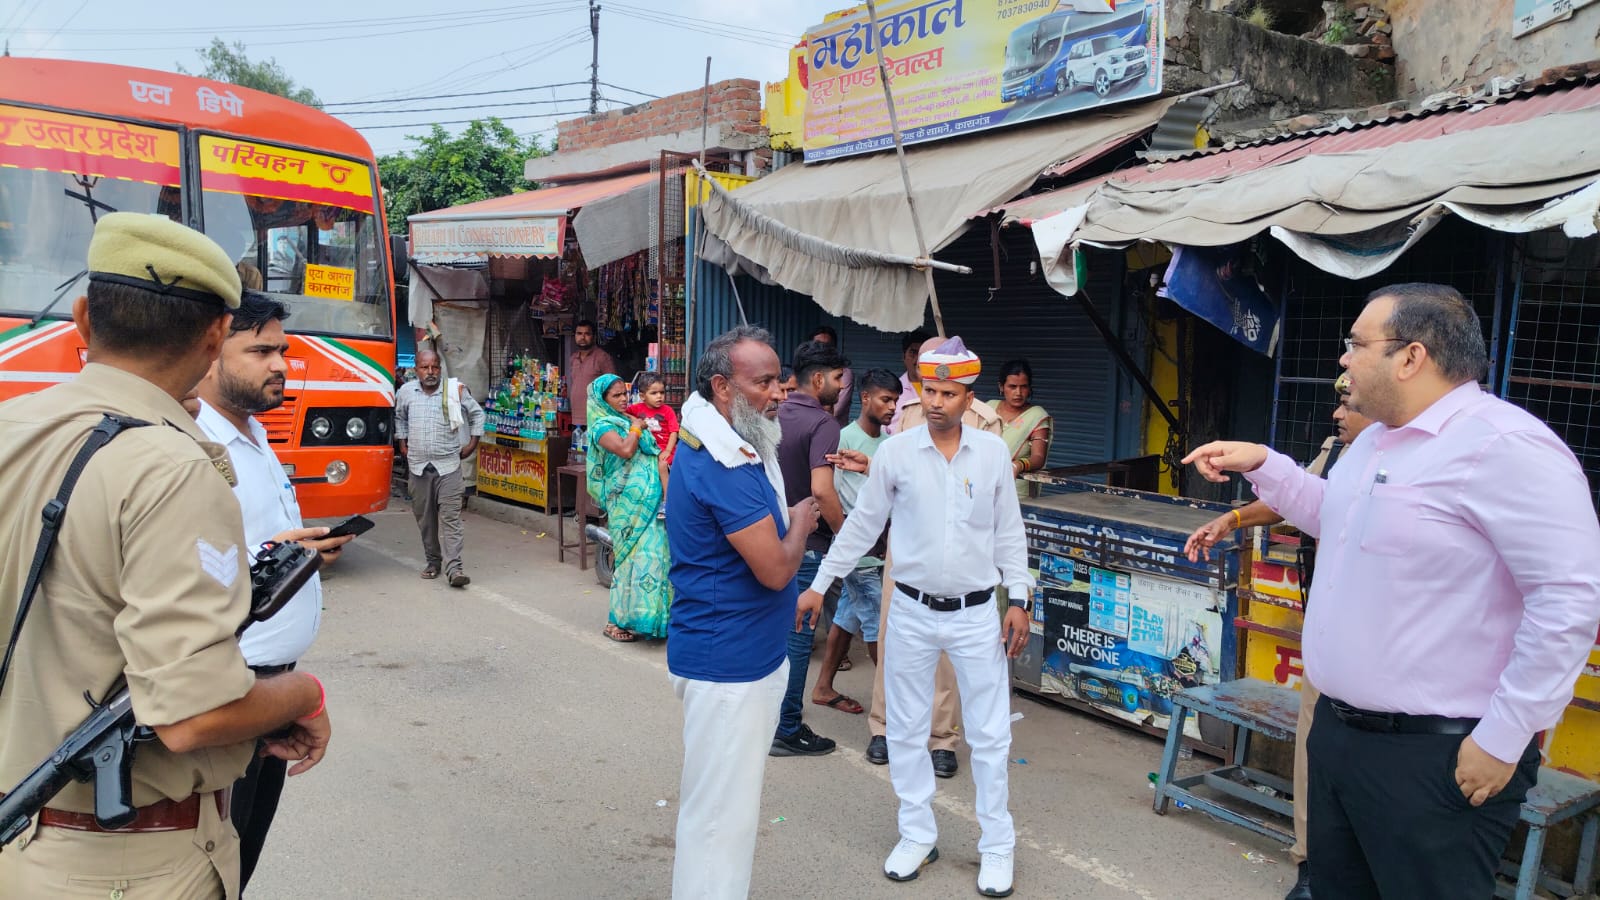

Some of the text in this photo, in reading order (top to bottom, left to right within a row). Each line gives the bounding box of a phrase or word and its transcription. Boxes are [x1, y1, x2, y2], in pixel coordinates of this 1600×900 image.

[811, 0, 966, 70] महाकाल
[128, 79, 244, 117] एटा डिपो
[811, 78, 836, 105] टूर
[838, 66, 879, 94] एण्ड
[24, 117, 158, 158] उत्तर प्रदेश
[212, 143, 309, 175] परिवहन
[308, 269, 352, 284] एटा आगरा
[308, 282, 351, 297] कासगंज
[1057, 638, 1120, 666] ONLY ONE
[1062, 624, 1115, 650] THERE IS
